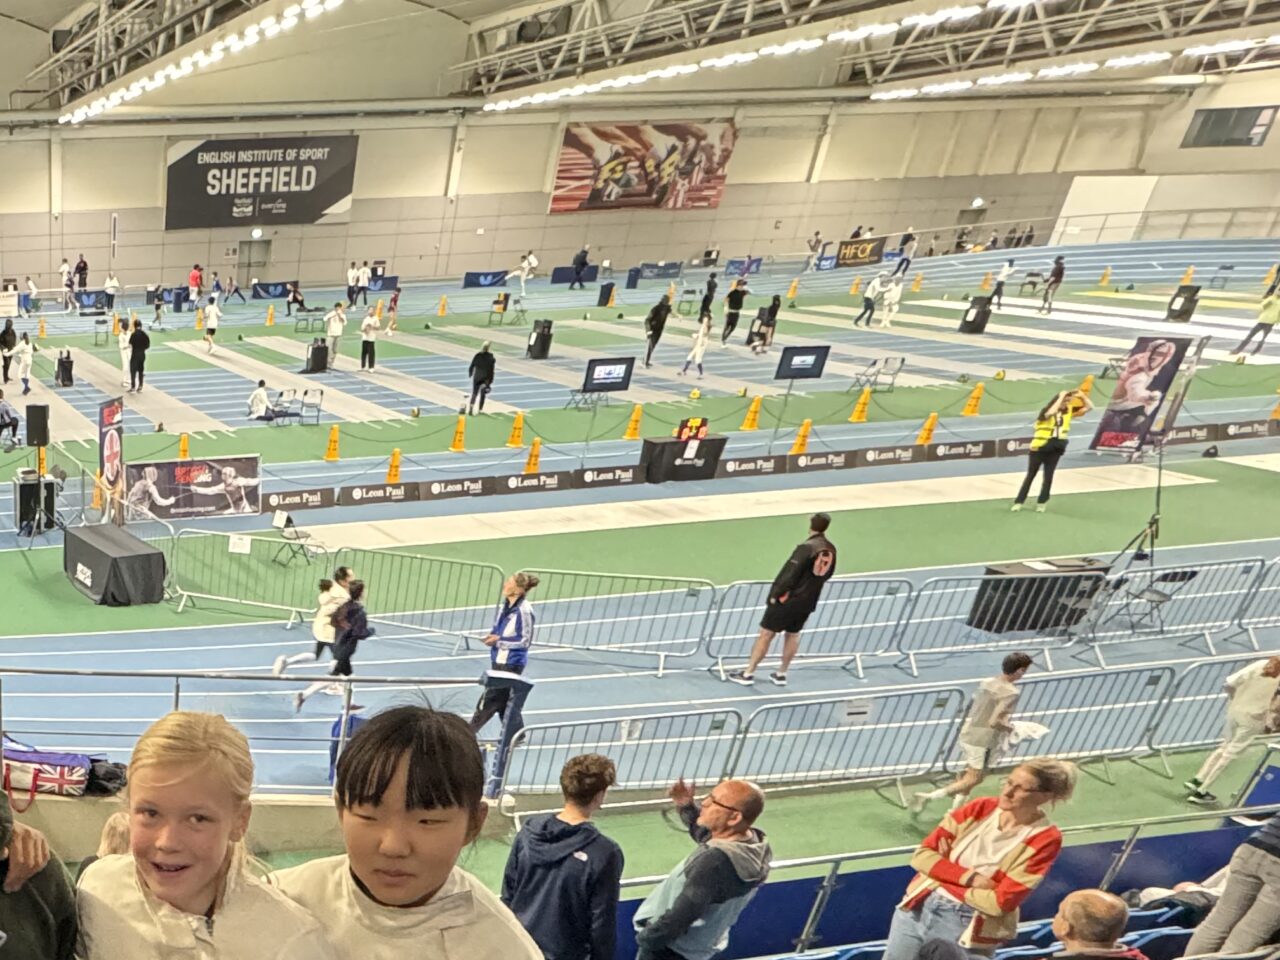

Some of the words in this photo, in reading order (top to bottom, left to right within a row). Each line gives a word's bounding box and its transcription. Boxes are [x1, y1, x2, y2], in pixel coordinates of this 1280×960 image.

[197, 151, 236, 164] ENGLISH
[237, 149, 284, 163] INSTITUTE
[285, 149, 298, 161] OF
[299, 148, 330, 161] SPORT
[206, 165, 317, 195] SHEFFIELD
[828, 454, 845, 464] Paul
[895, 448, 912, 458] Paul
[735, 461, 755, 471] Leon
[757, 459, 775, 469] Paul
[517, 477, 539, 487] Leon
[540, 475, 558, 485] Paul
[593, 471, 613, 481] Leon
[615, 469, 633, 479] Paul
[362, 488, 384, 498] Leon
[386, 486, 405, 496] Paul
[440, 483, 462, 493] Leon
[464, 480, 482, 490] Paul
[280, 495, 301, 505] Leon
[303, 492, 321, 503] Paul
